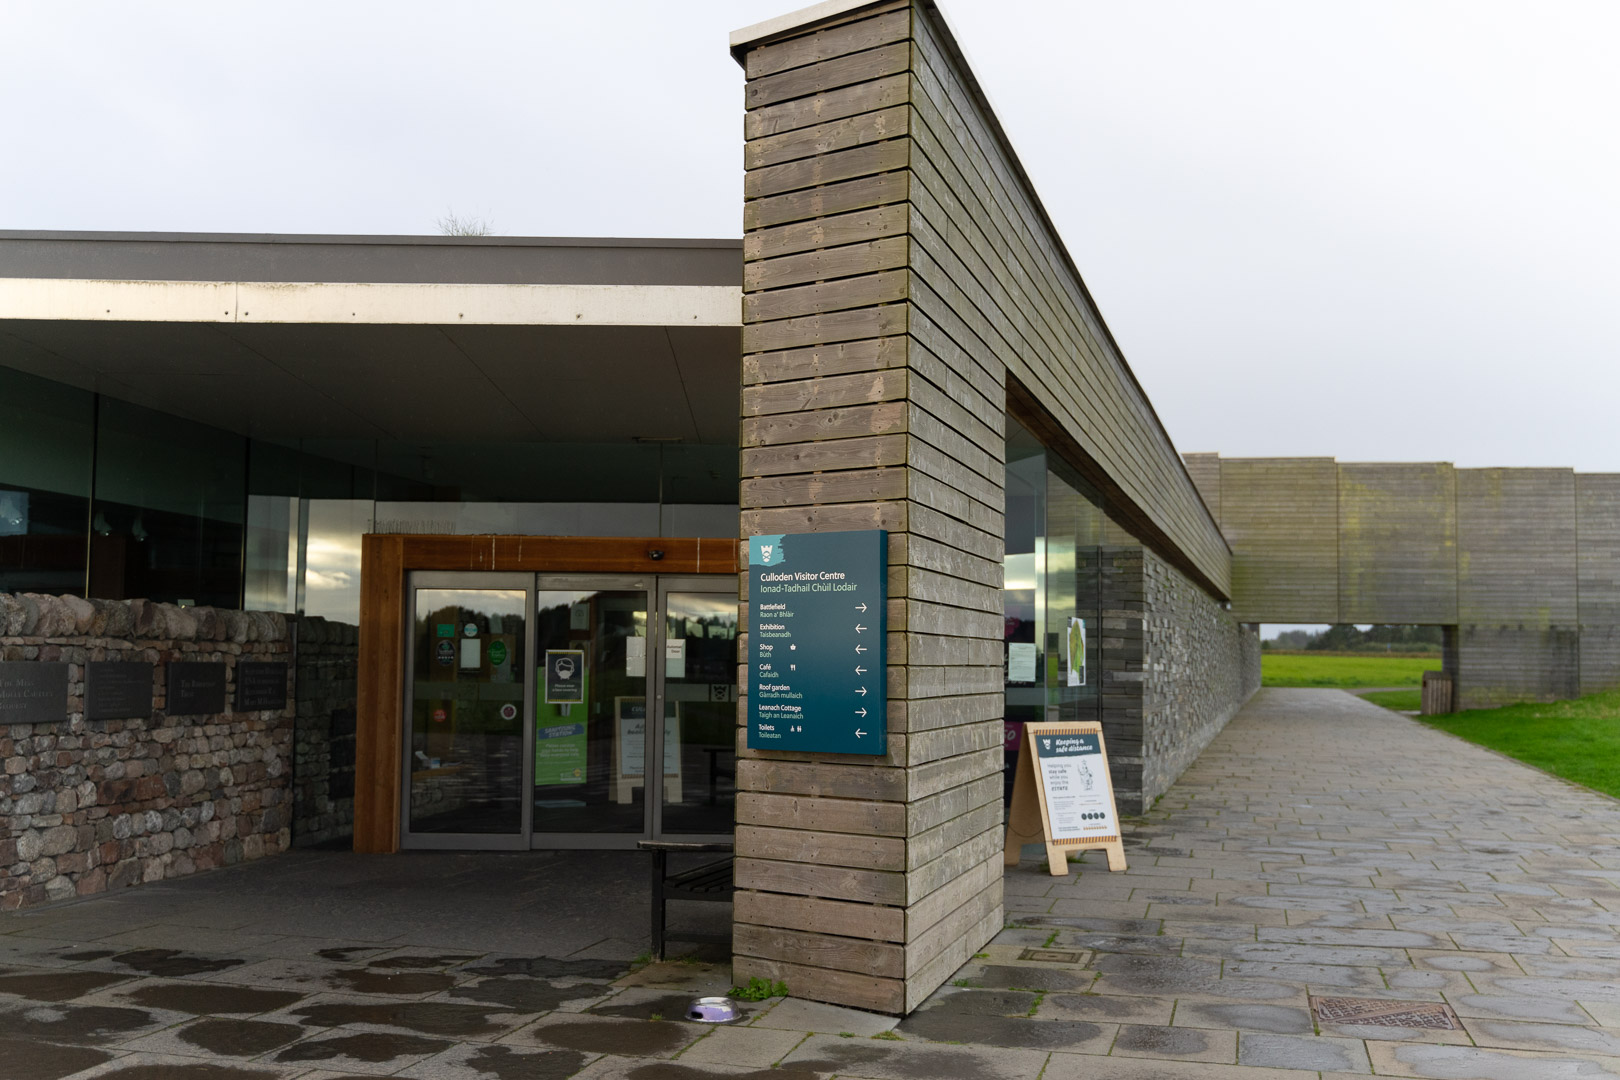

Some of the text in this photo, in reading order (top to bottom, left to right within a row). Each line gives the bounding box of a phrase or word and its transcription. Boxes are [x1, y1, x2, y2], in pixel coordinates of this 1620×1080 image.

[760, 571, 845, 582] Culloden Visitor Centre
[760, 582, 857, 593] Ionad-Tadhail Chùil Lodair
[759, 643, 774, 651] Shop
[759, 663, 772, 671] Café
[759, 683, 790, 692] Roof garden
[780, 704, 802, 713] Cottage
[758, 711, 773, 719] Taigh
[780, 712, 804, 720] Leanaich
[758, 723, 775, 731] Toilets
[758, 731, 782, 739] Toileatan
[1055, 738, 1079, 746] Keeping
